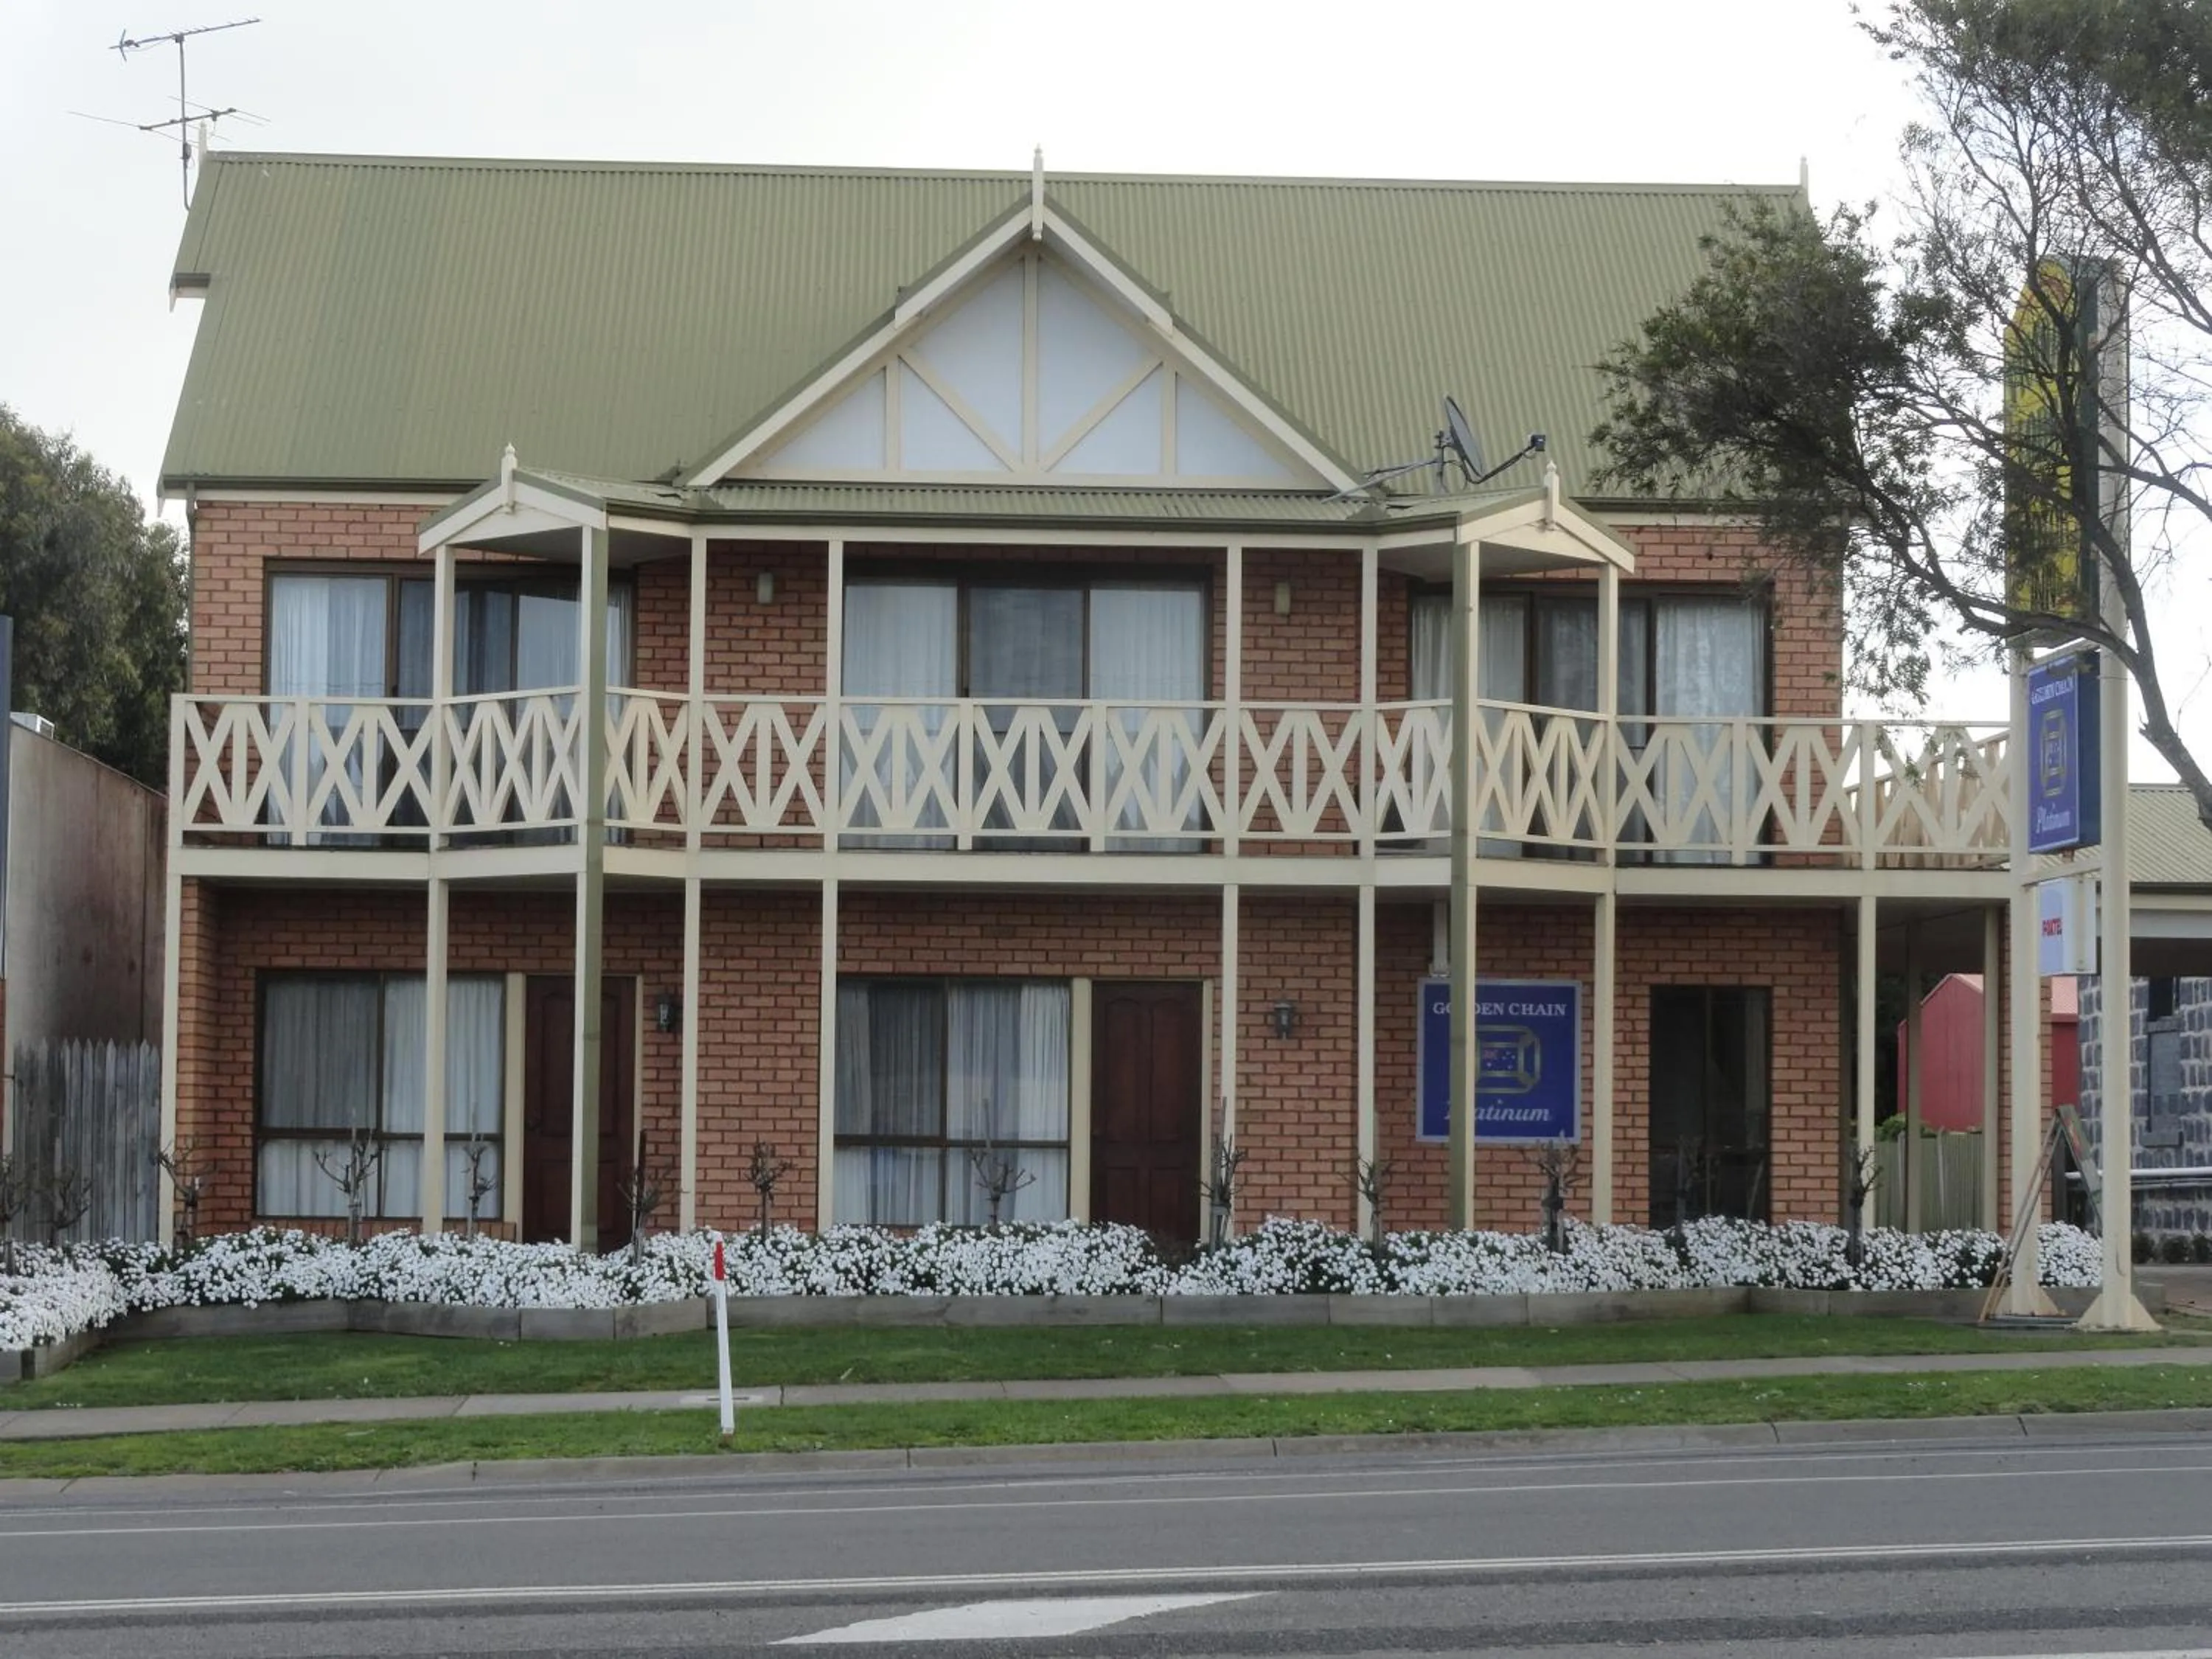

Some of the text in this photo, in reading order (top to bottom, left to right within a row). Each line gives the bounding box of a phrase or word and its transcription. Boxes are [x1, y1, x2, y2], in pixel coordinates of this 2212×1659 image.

[1433, 1002, 1567, 1016] GDEN CHAIN
[1444, 1099, 1551, 1121] atinum
